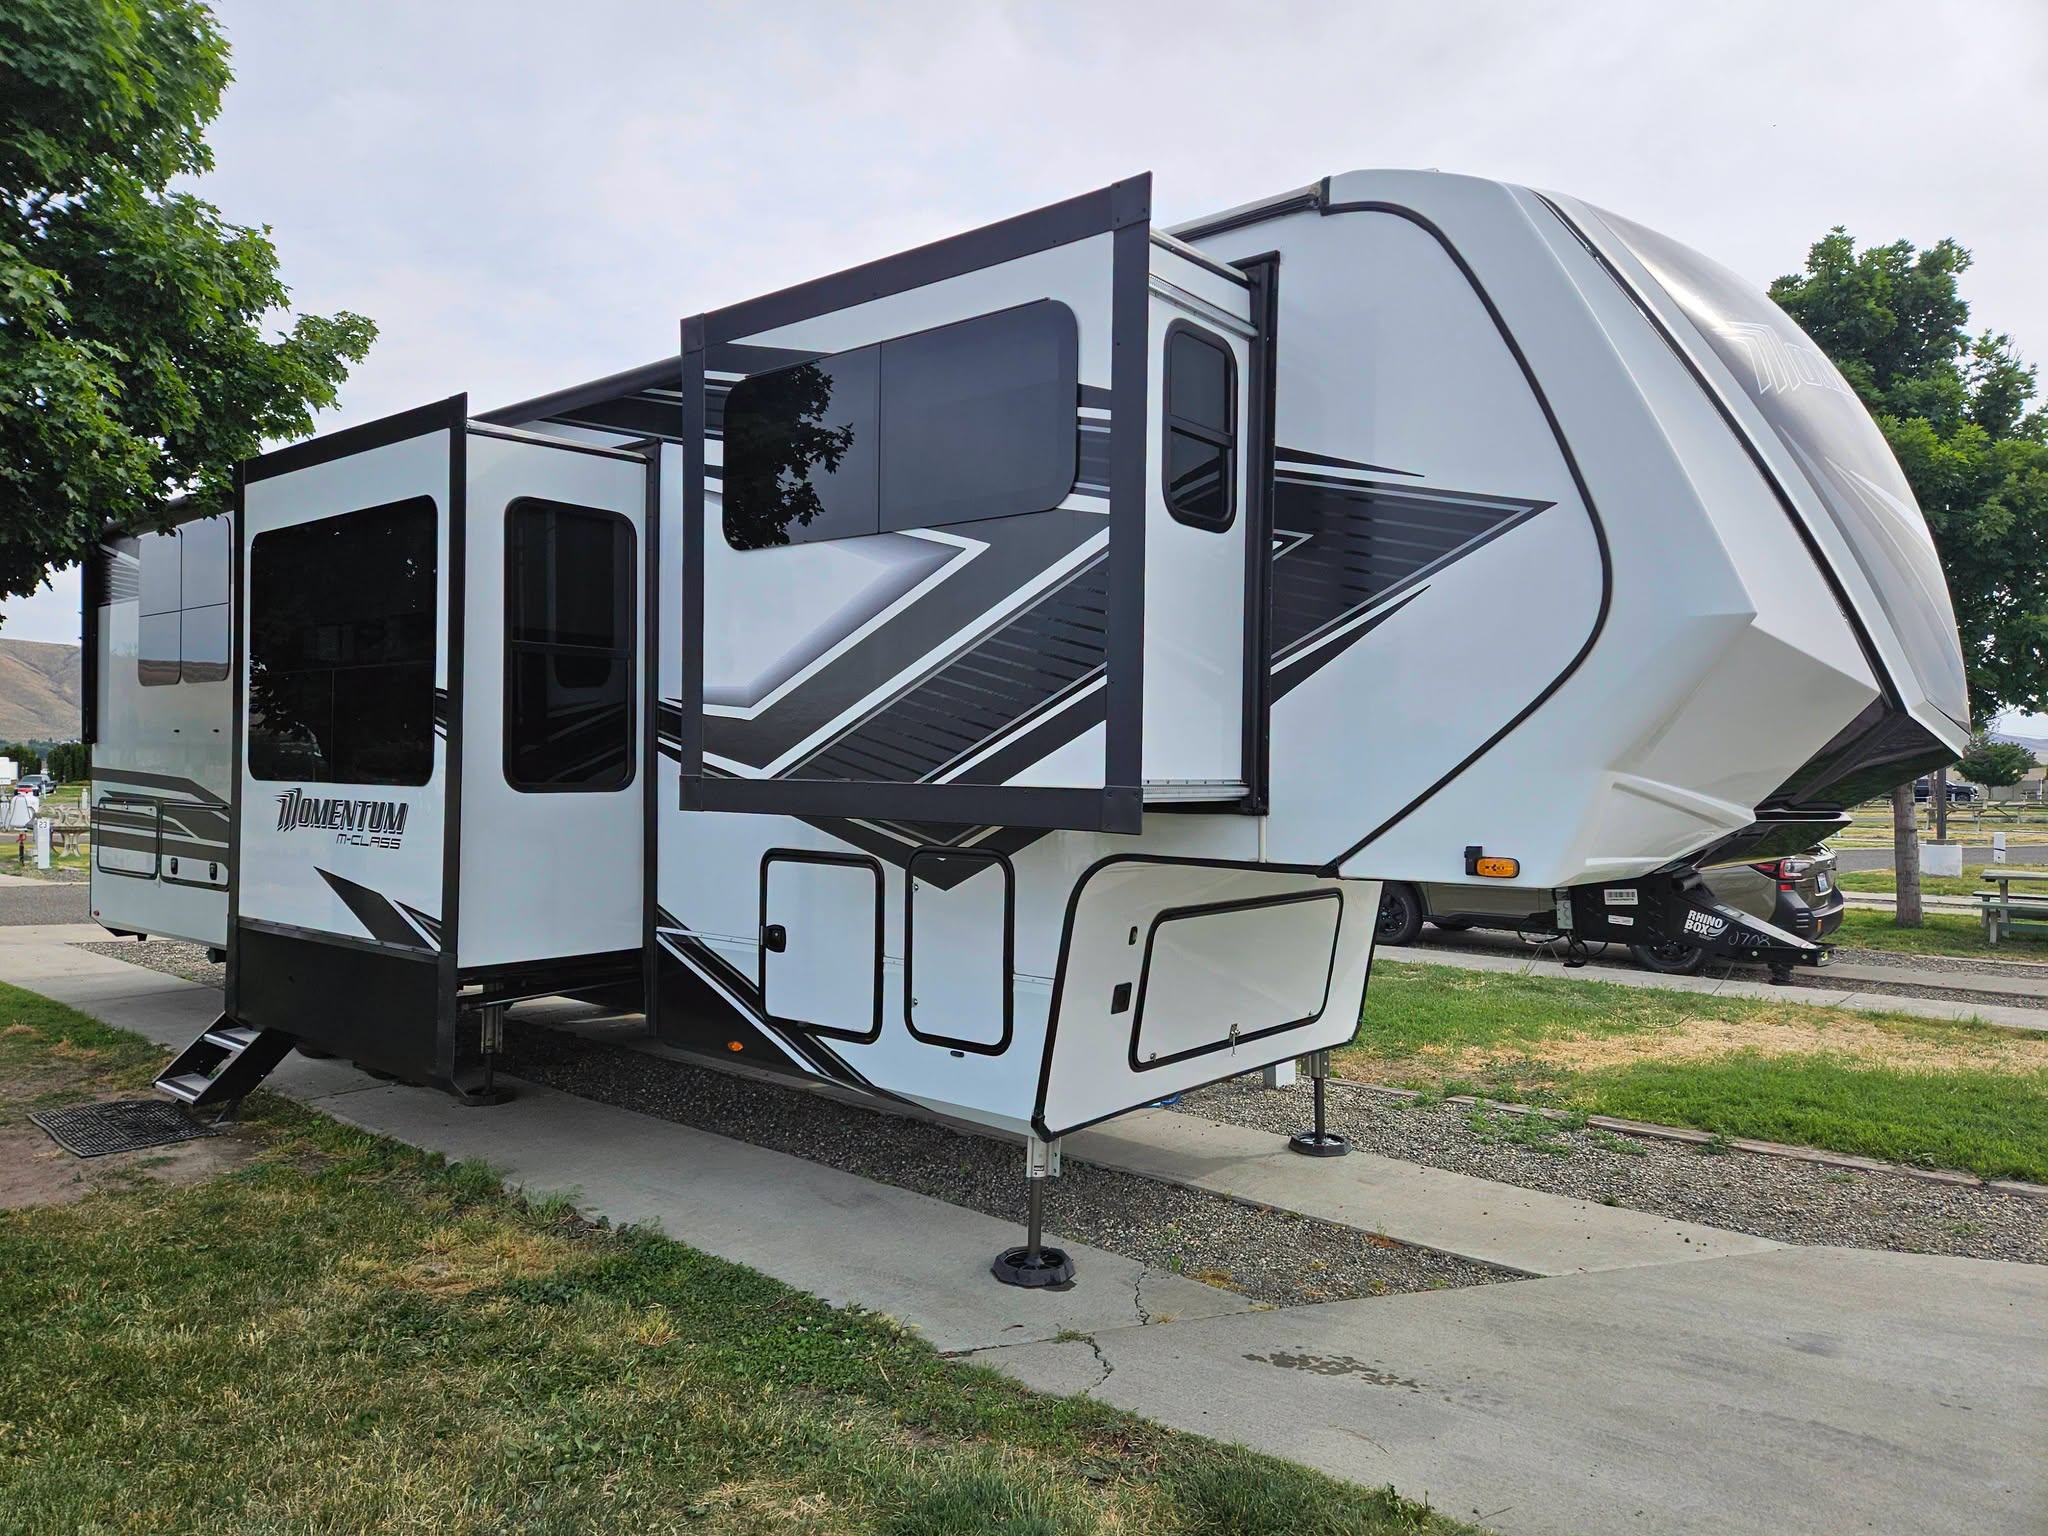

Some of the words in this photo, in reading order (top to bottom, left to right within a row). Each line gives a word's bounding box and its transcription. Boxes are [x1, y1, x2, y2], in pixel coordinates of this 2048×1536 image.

[273, 787, 409, 835] MOMENTUM
[1684, 919, 1710, 935] BOX
[1688, 909, 1723, 928] RHINO
